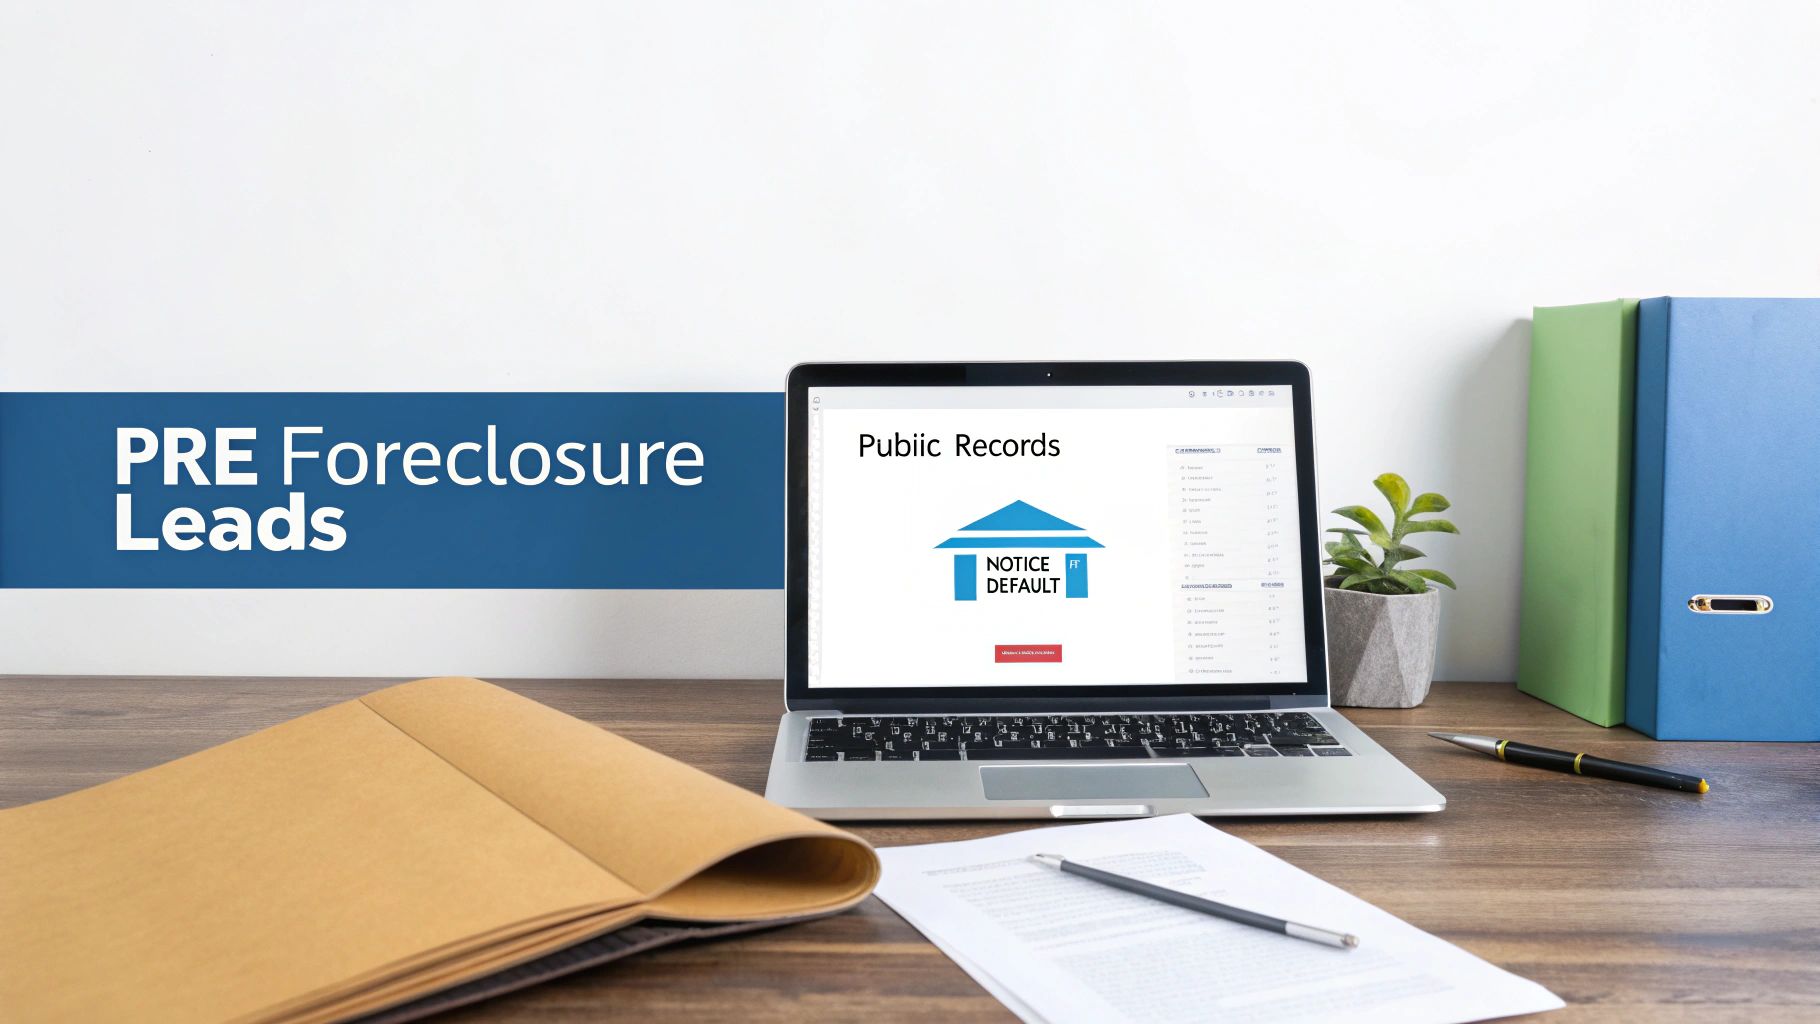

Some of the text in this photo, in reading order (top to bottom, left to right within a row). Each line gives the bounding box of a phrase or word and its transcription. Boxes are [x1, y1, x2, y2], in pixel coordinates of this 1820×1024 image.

[116, 424, 705, 486] PRE Foreclosure
[956, 432, 1061, 457] Records
[116, 491, 347, 552] Leads
[986, 556, 1050, 573] NOTICE
[987, 577, 1061, 594] DEFAULT
